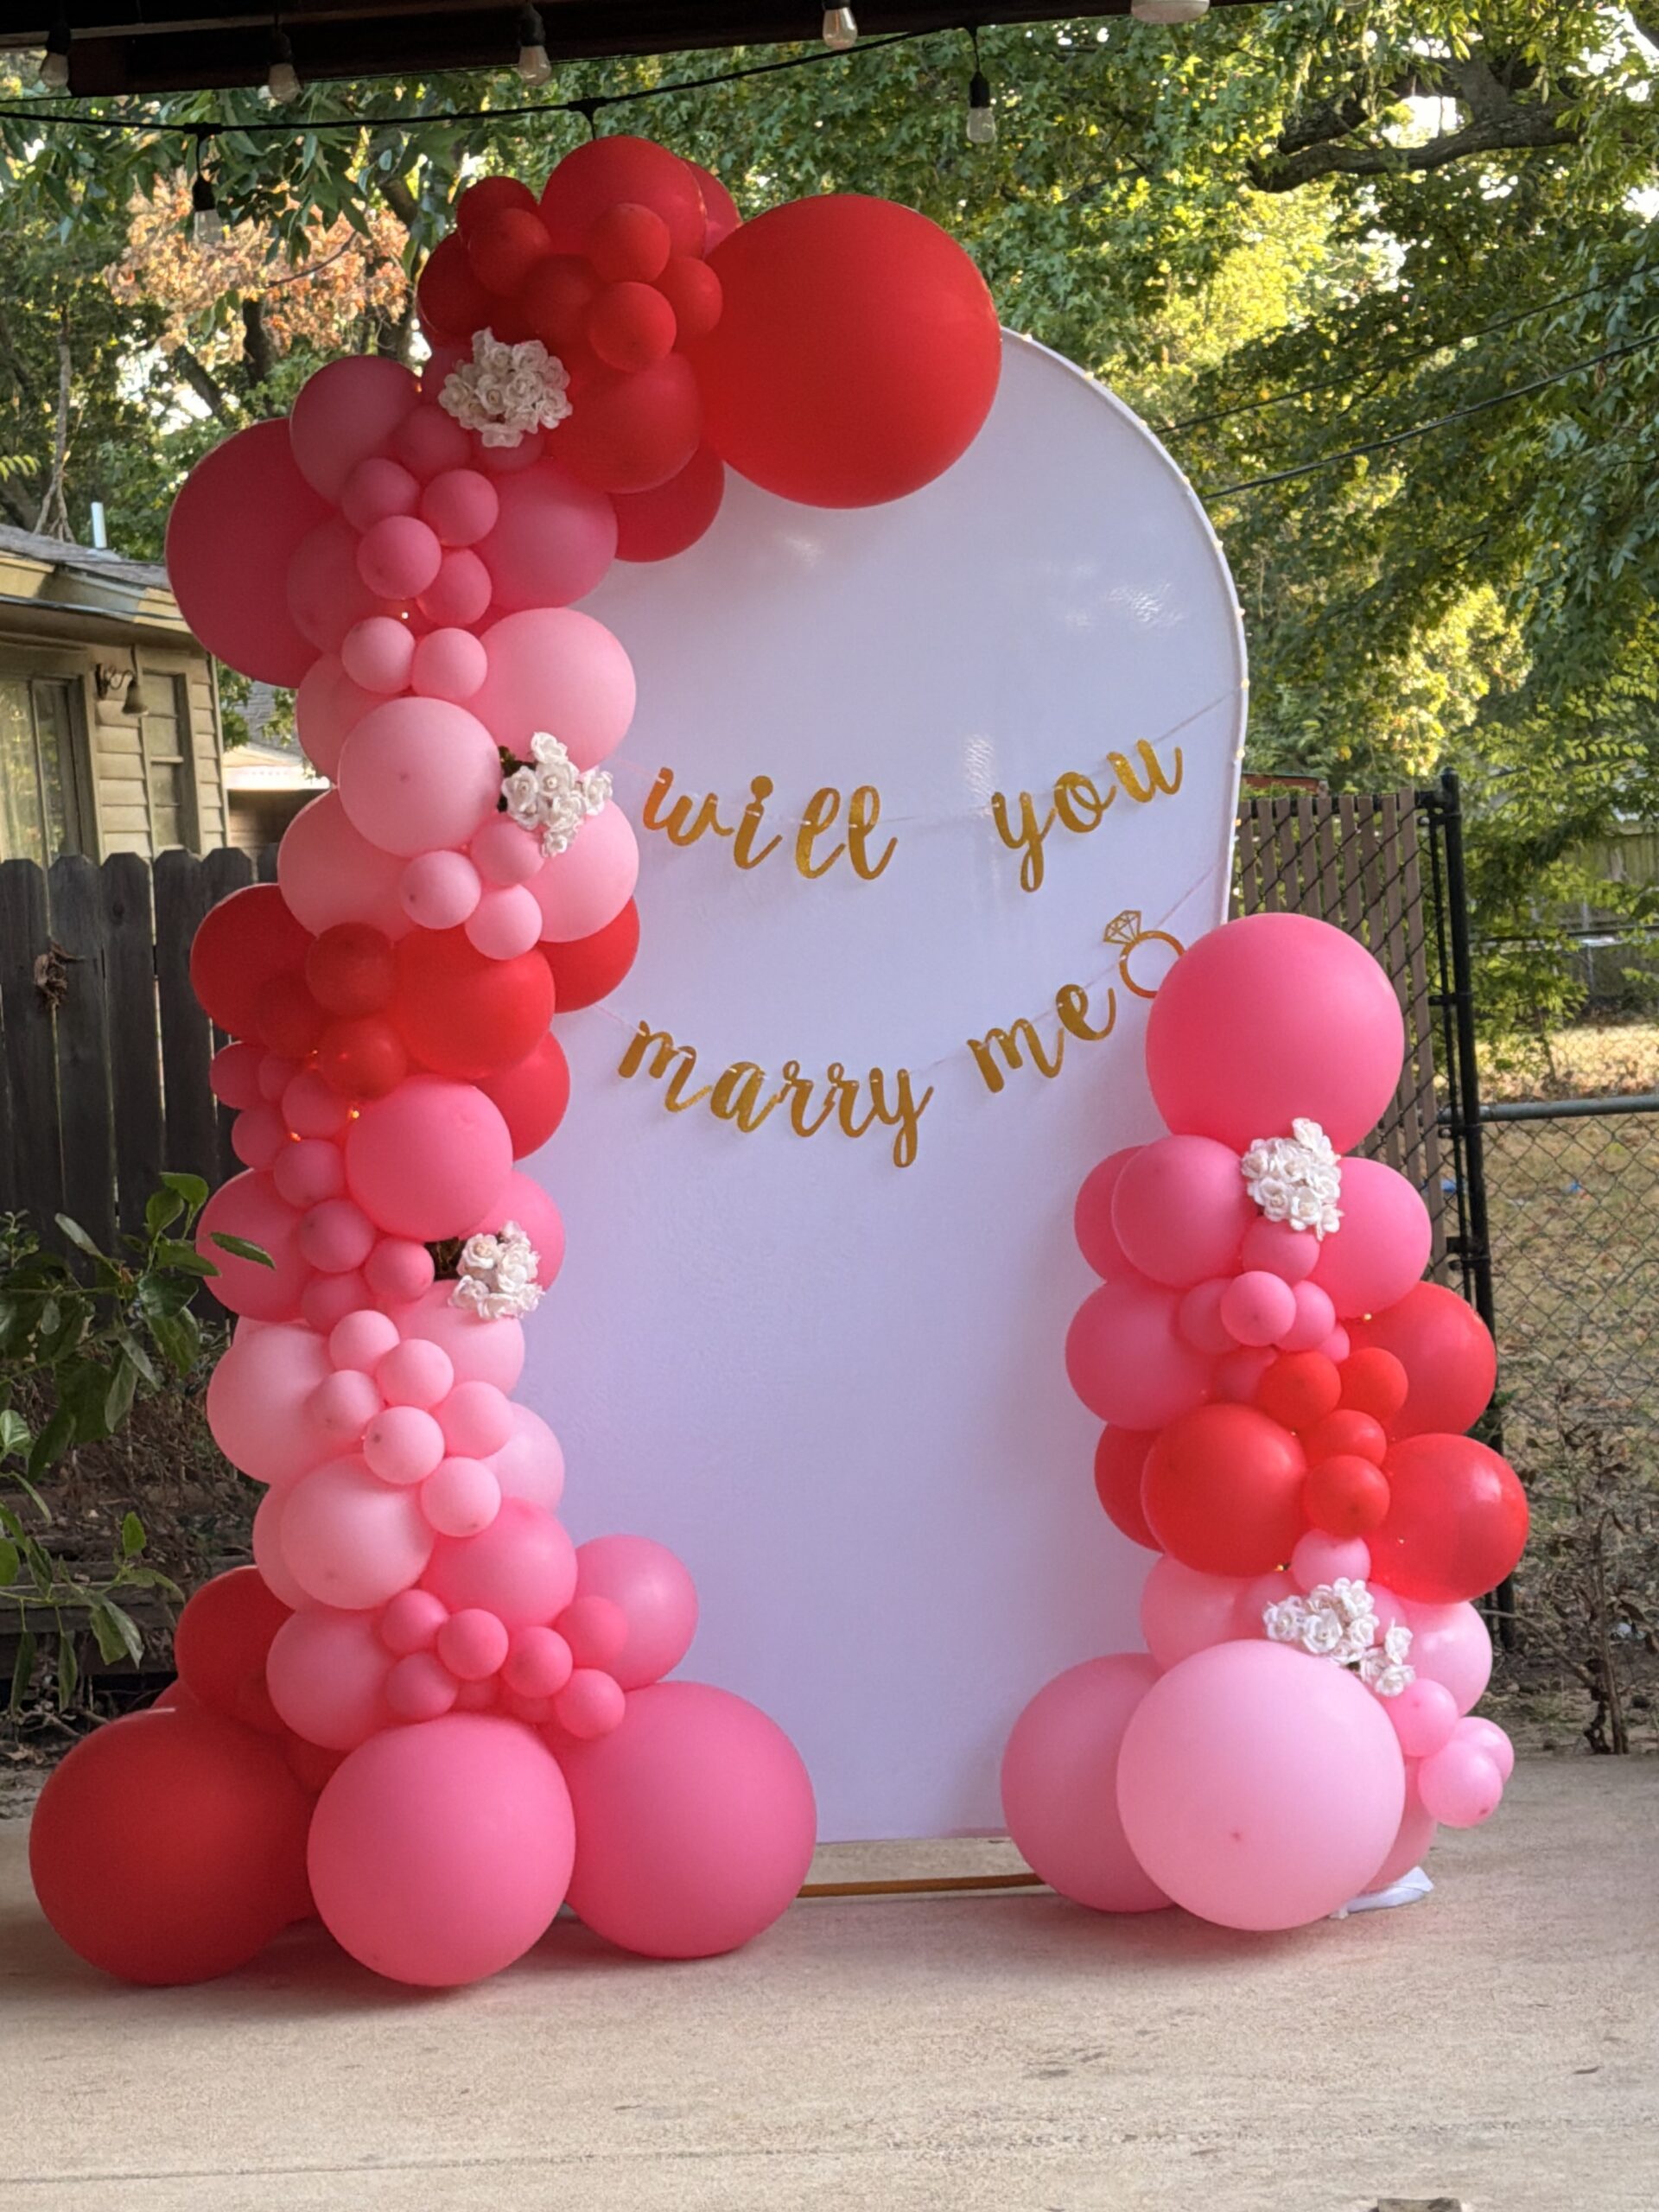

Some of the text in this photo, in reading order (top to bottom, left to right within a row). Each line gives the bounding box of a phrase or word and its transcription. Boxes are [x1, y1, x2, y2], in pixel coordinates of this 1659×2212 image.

[642, 741, 1182, 891] will you
[618, 984, 1116, 1167] marry me
